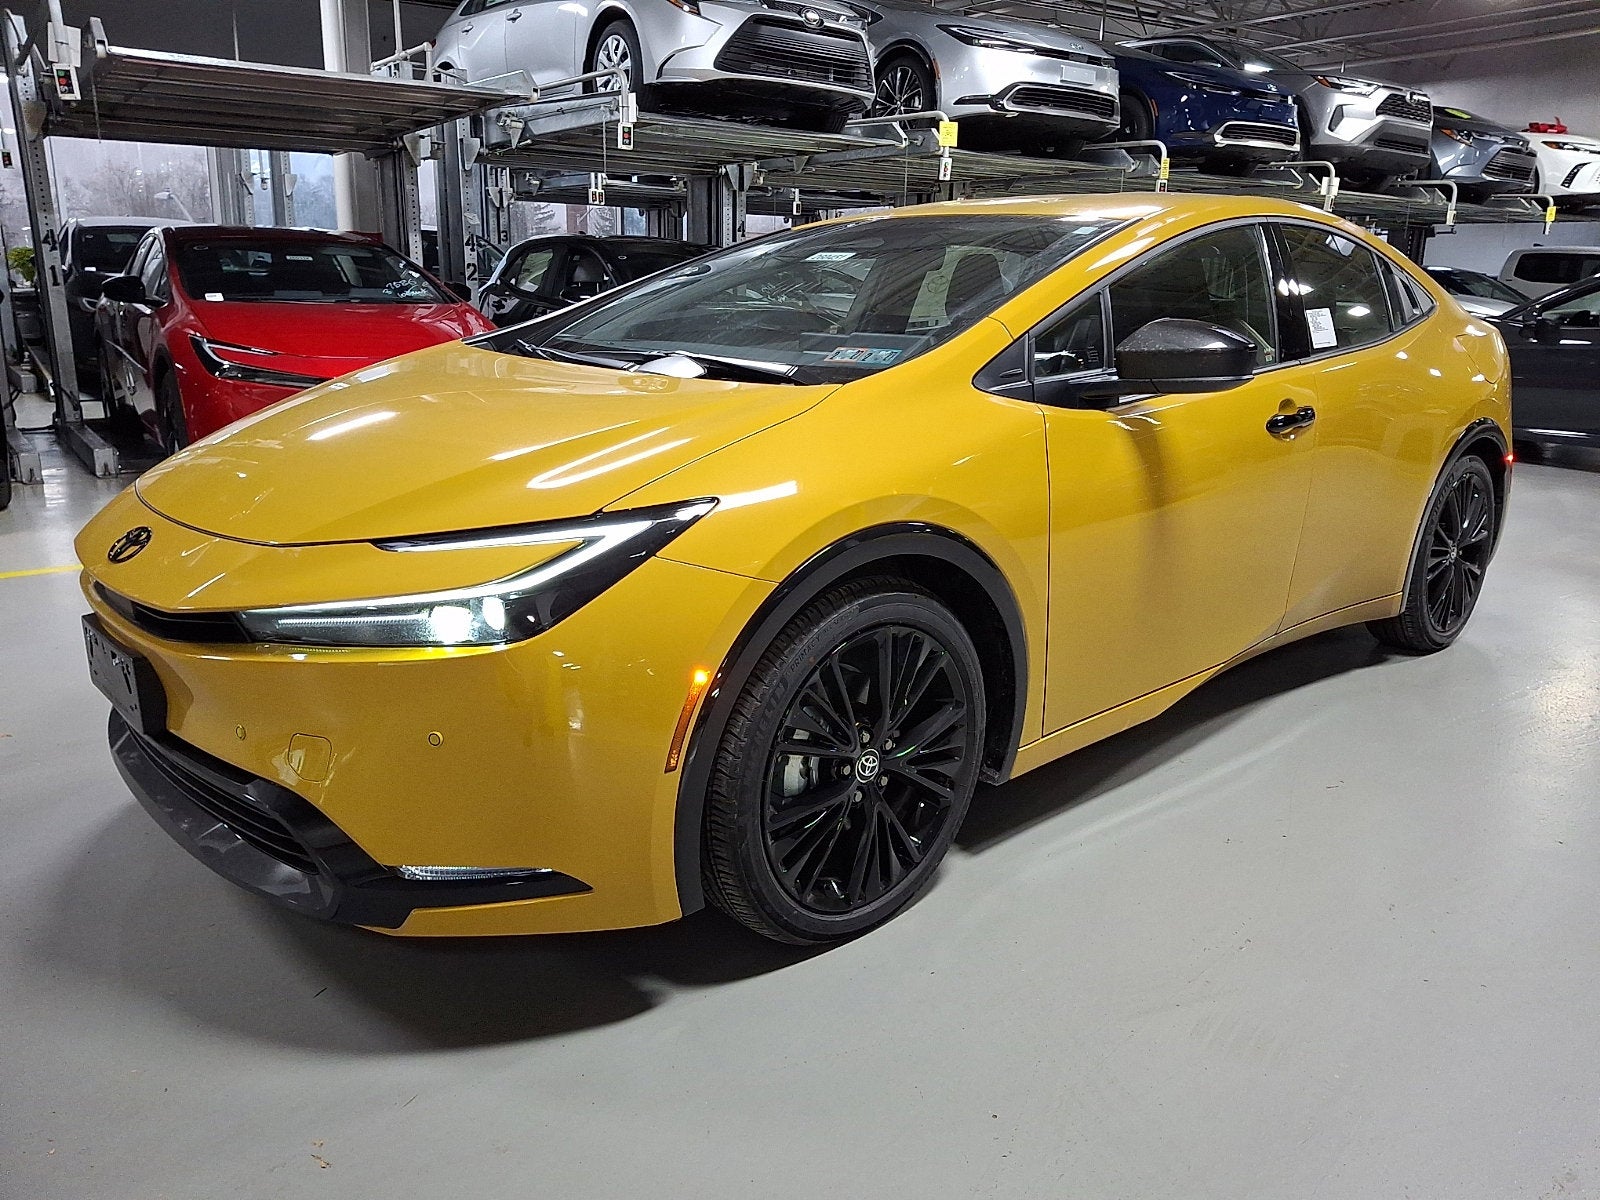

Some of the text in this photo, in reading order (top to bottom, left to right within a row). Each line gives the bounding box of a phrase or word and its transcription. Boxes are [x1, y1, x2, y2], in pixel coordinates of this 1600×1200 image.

[501, 230, 509, 242] 3
[736, 220, 746, 237] 4
[42, 229, 58, 252] 4
[465, 234, 476, 252] 4
[49, 265, 60, 286] 1
[466, 263, 478, 281] 2
